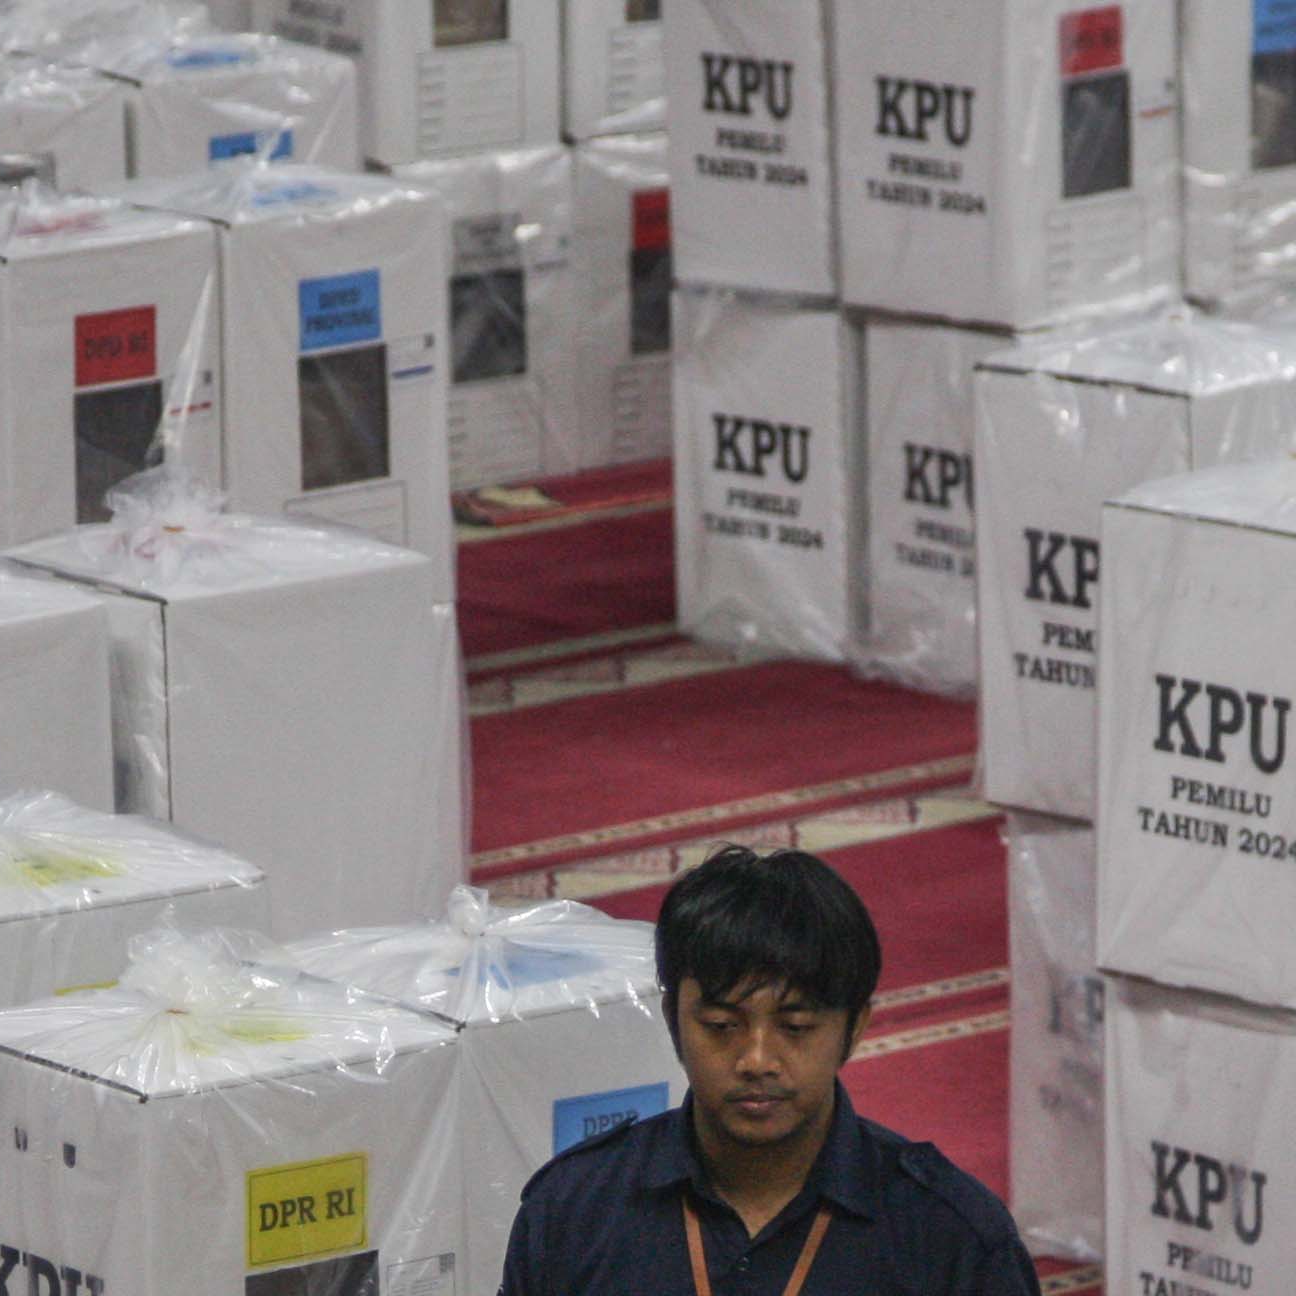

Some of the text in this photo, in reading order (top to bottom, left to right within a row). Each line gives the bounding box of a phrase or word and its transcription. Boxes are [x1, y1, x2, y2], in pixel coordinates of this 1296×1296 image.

[701, 53, 794, 120] KPU
[875, 75, 974, 148] KPU
[713, 412, 811, 483] KPU
[1024, 528, 1101, 609] KP
[1042, 621, 1095, 652] PEM
[1154, 674, 1291, 775] KPU
[1138, 806, 1228, 847] TAHUN
[1170, 775, 1272, 818] PEMILU
[257, 1186, 356, 1233] DPR RI
[1151, 1141, 1267, 1246] KPU
